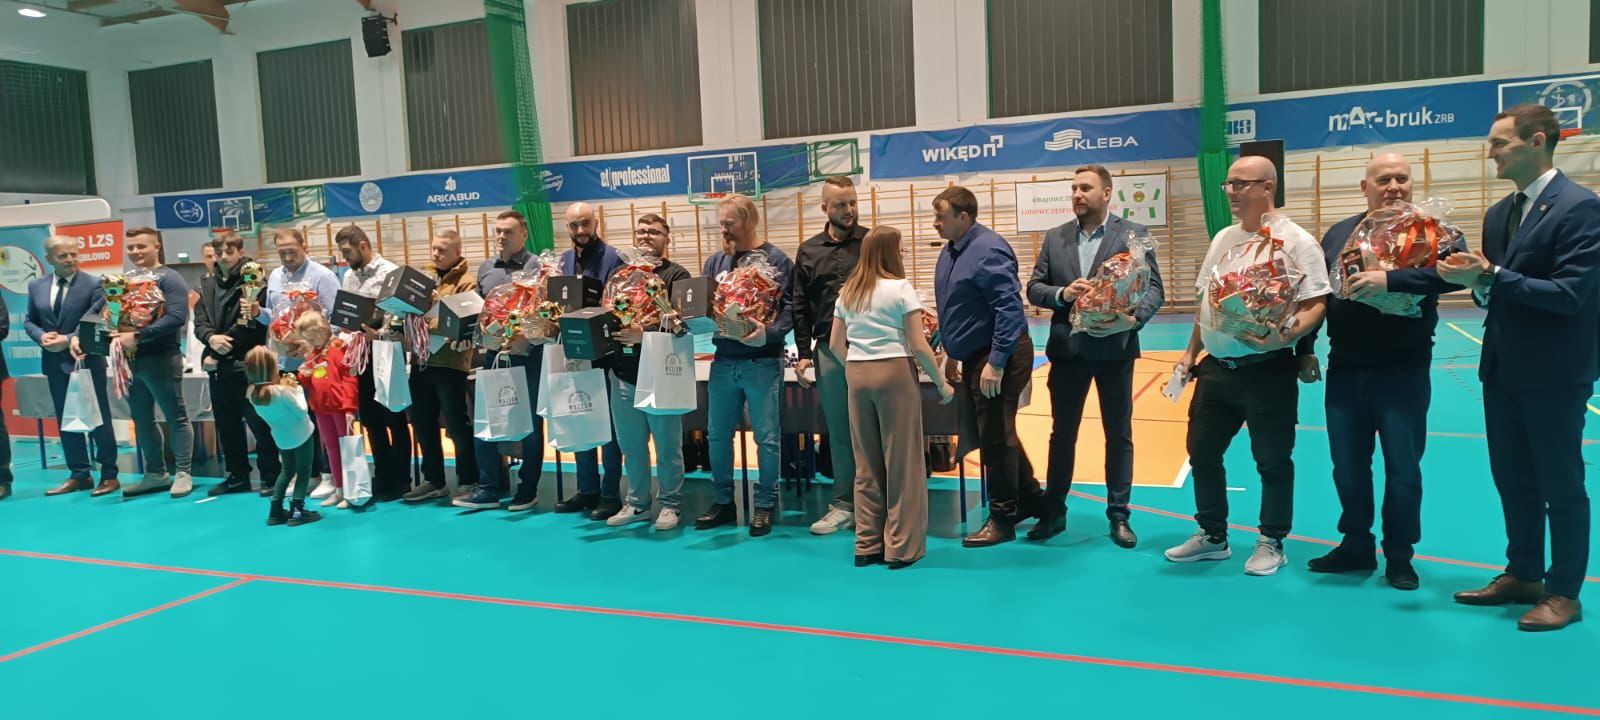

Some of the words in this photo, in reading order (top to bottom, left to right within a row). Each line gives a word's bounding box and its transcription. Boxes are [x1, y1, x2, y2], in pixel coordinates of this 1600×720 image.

[1434, 113, 1455, 124] ZRB
[1074, 135, 1139, 150] KLEBA
[921, 144, 982, 162] WIKĘD
[426, 191, 480, 204] ARKABUD
[89, 233, 114, 248] LZS
